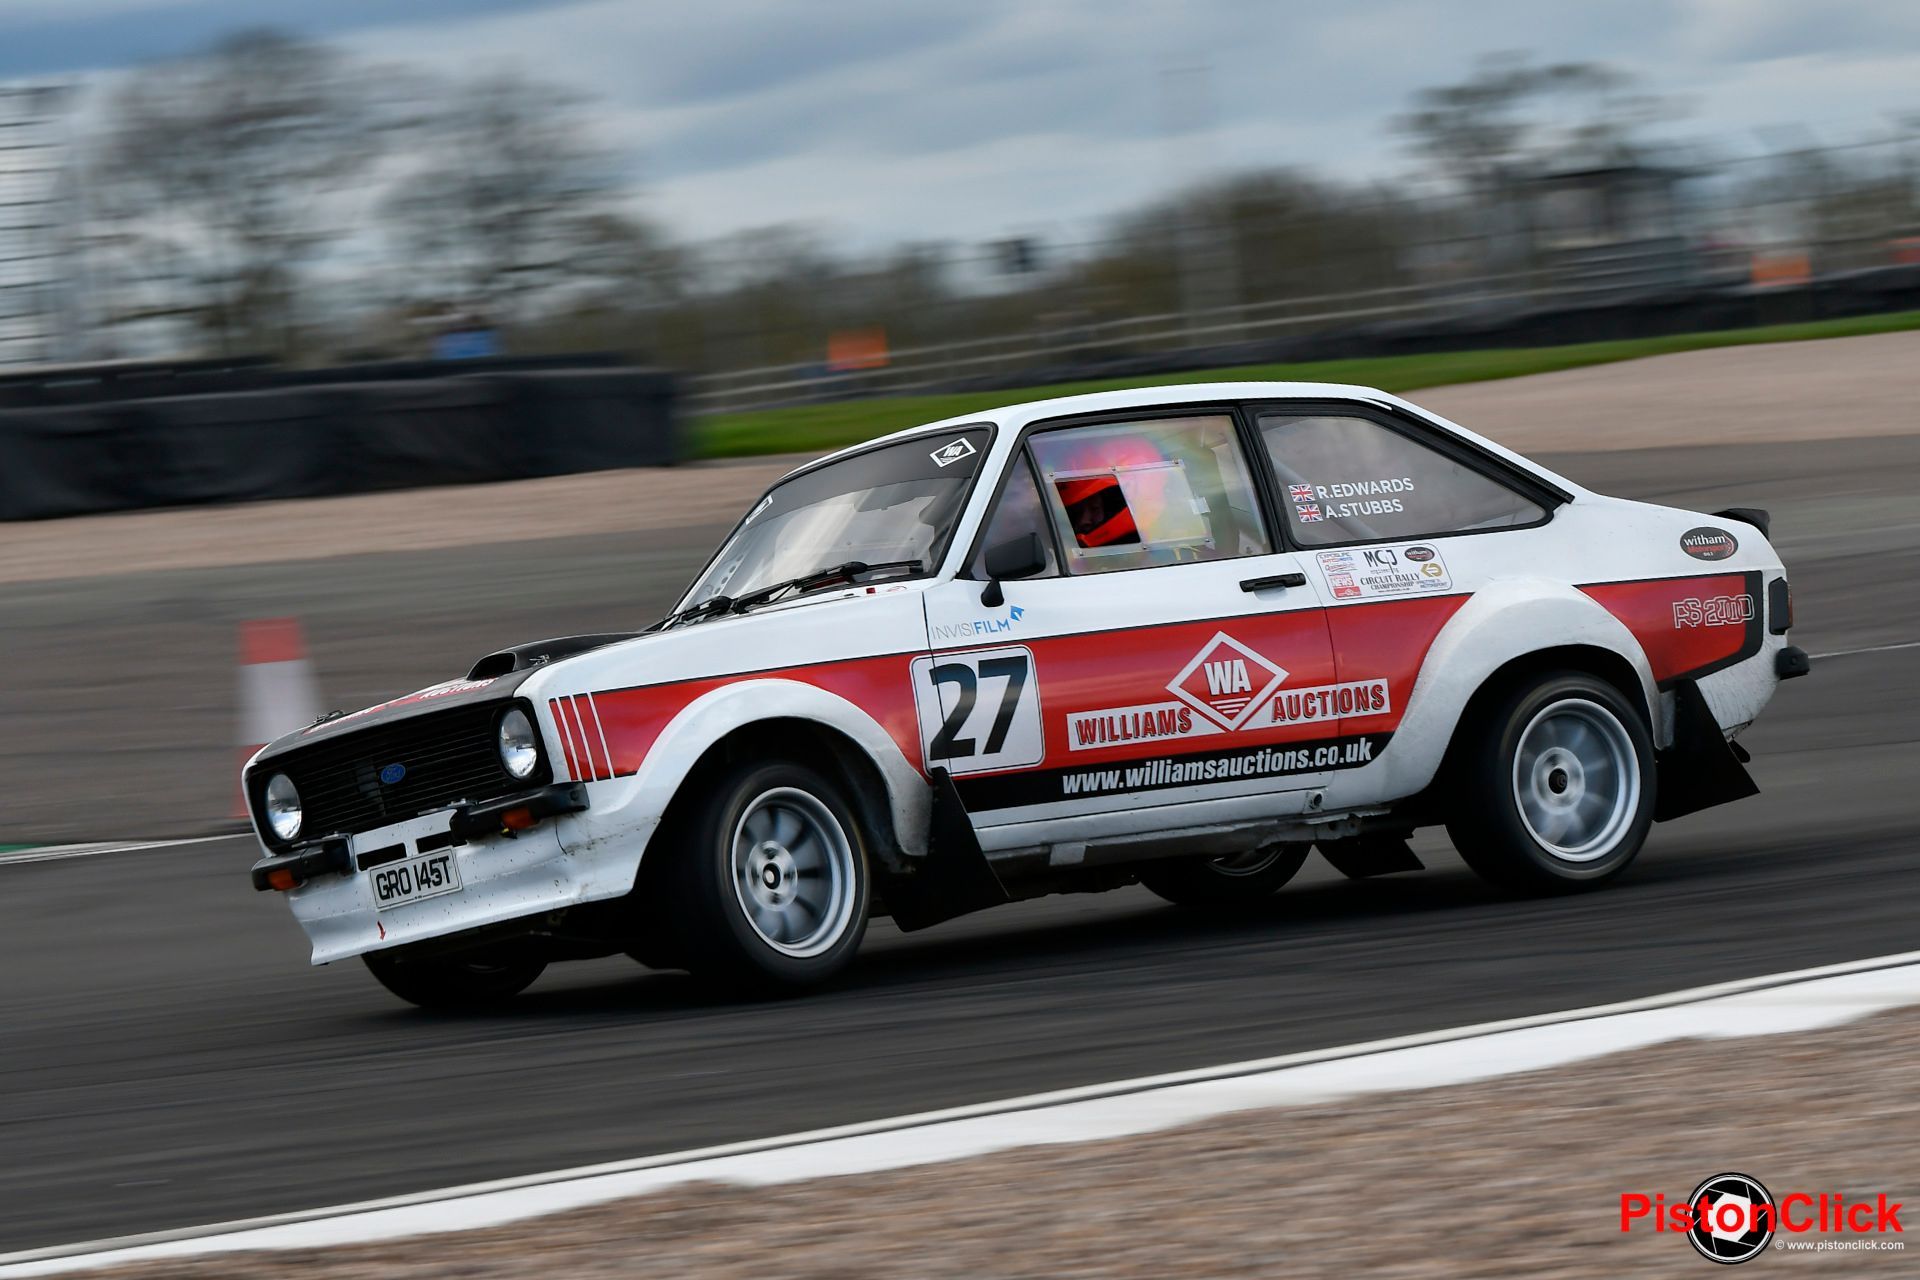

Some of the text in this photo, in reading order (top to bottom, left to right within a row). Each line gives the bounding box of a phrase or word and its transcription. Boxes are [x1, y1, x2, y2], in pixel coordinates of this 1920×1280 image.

[1316, 478, 1414, 499] R.EDWARDS
[1325, 498, 1404, 519] A.STUBBS
[1683, 534, 1726, 546] witham
[1360, 574, 1394, 586] CIRCUIT
[1394, 572, 1420, 582] RALLY
[1370, 580, 1415, 591] CHAMPIONSHIP
[931, 617, 1012, 641] INVISIFILM
[1203, 659, 1252, 696] WA
[928, 655, 1028, 761] 27
[1075, 683, 1386, 746] WILLIAMS AUCTIONS
[1062, 737, 1372, 795] www.williamsauctions.co.uk
[376, 855, 451, 901] GRO 145T
